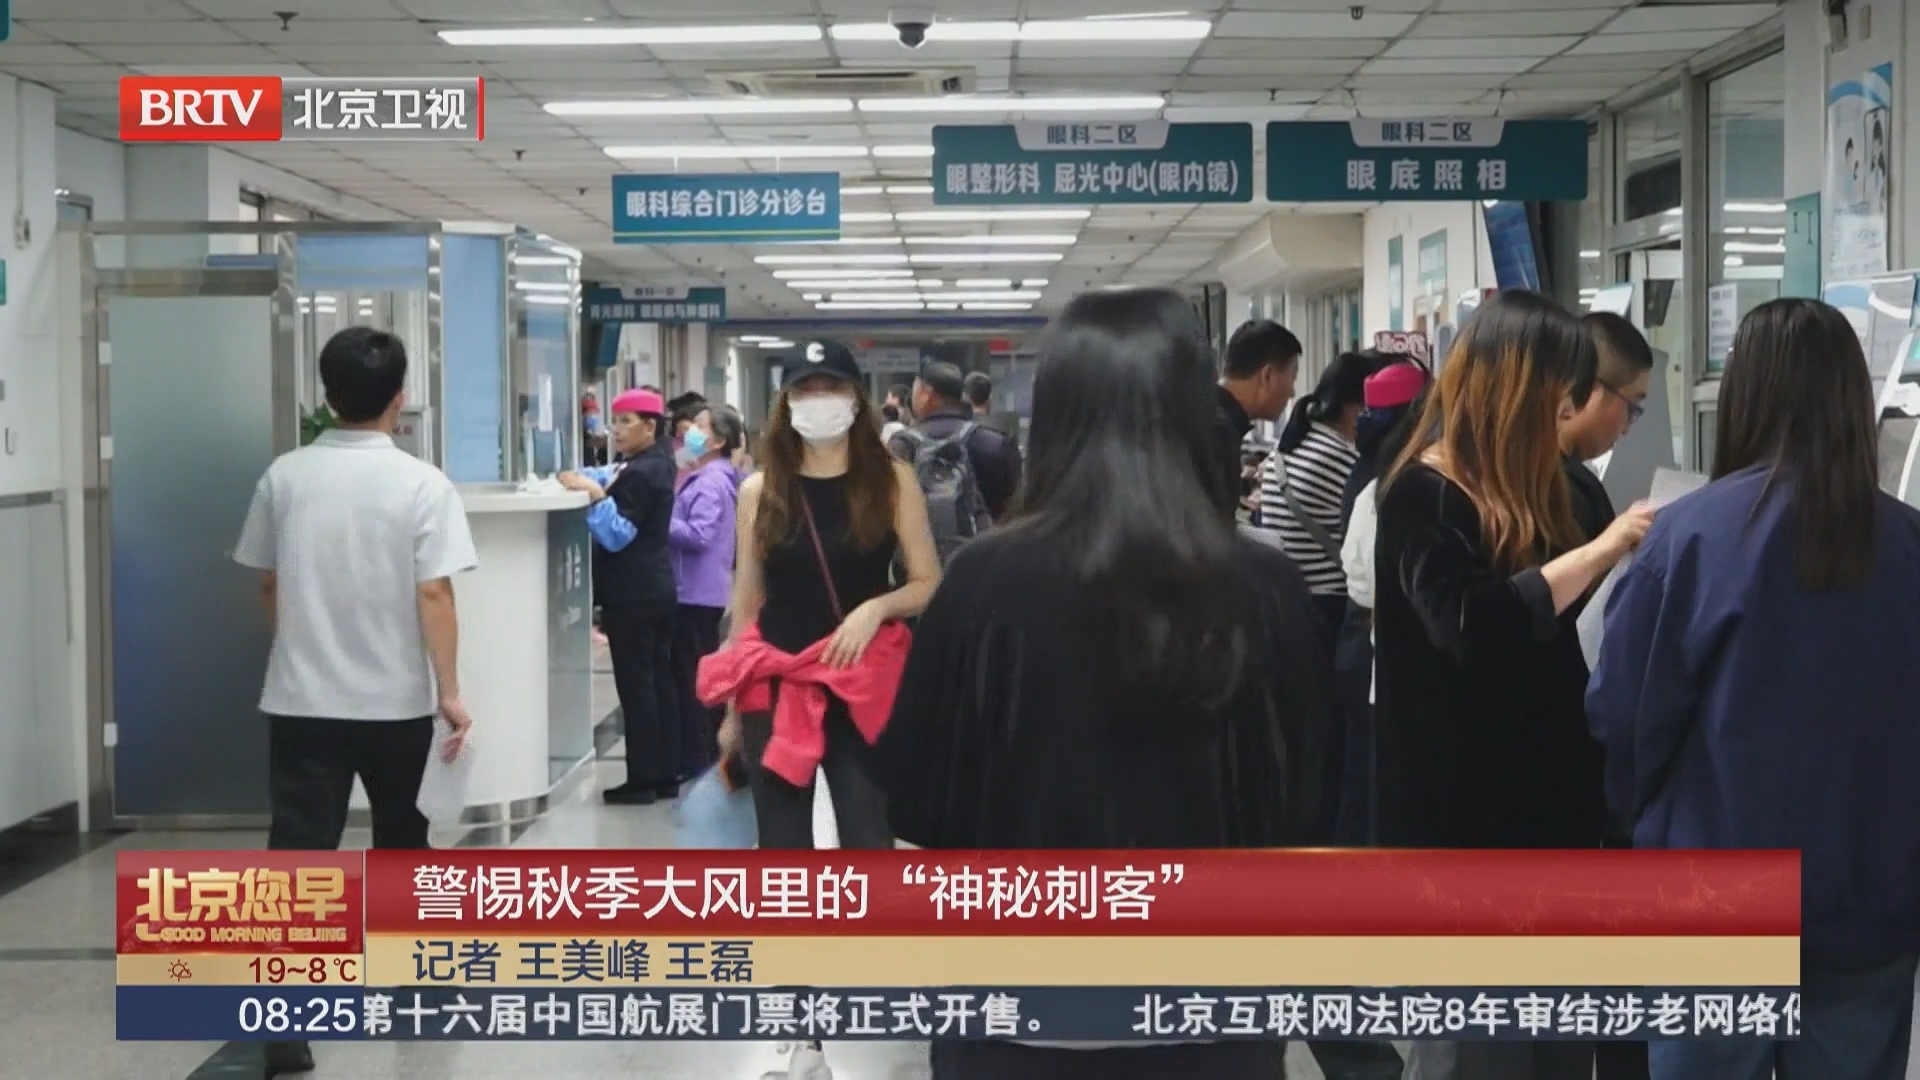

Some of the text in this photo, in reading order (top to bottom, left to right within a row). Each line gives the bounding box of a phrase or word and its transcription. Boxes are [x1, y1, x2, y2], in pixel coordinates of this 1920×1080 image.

[1047, 124, 1138, 145] 眼科二区
[1382, 121, 1473, 143] 眼科二区
[946, 159, 1239, 196] 眼整形科 屈光中心(眼内镜)
[1346, 157, 1507, 191] 眼底照相
[626, 188, 827, 218] 眼科综合门诊分诊台
